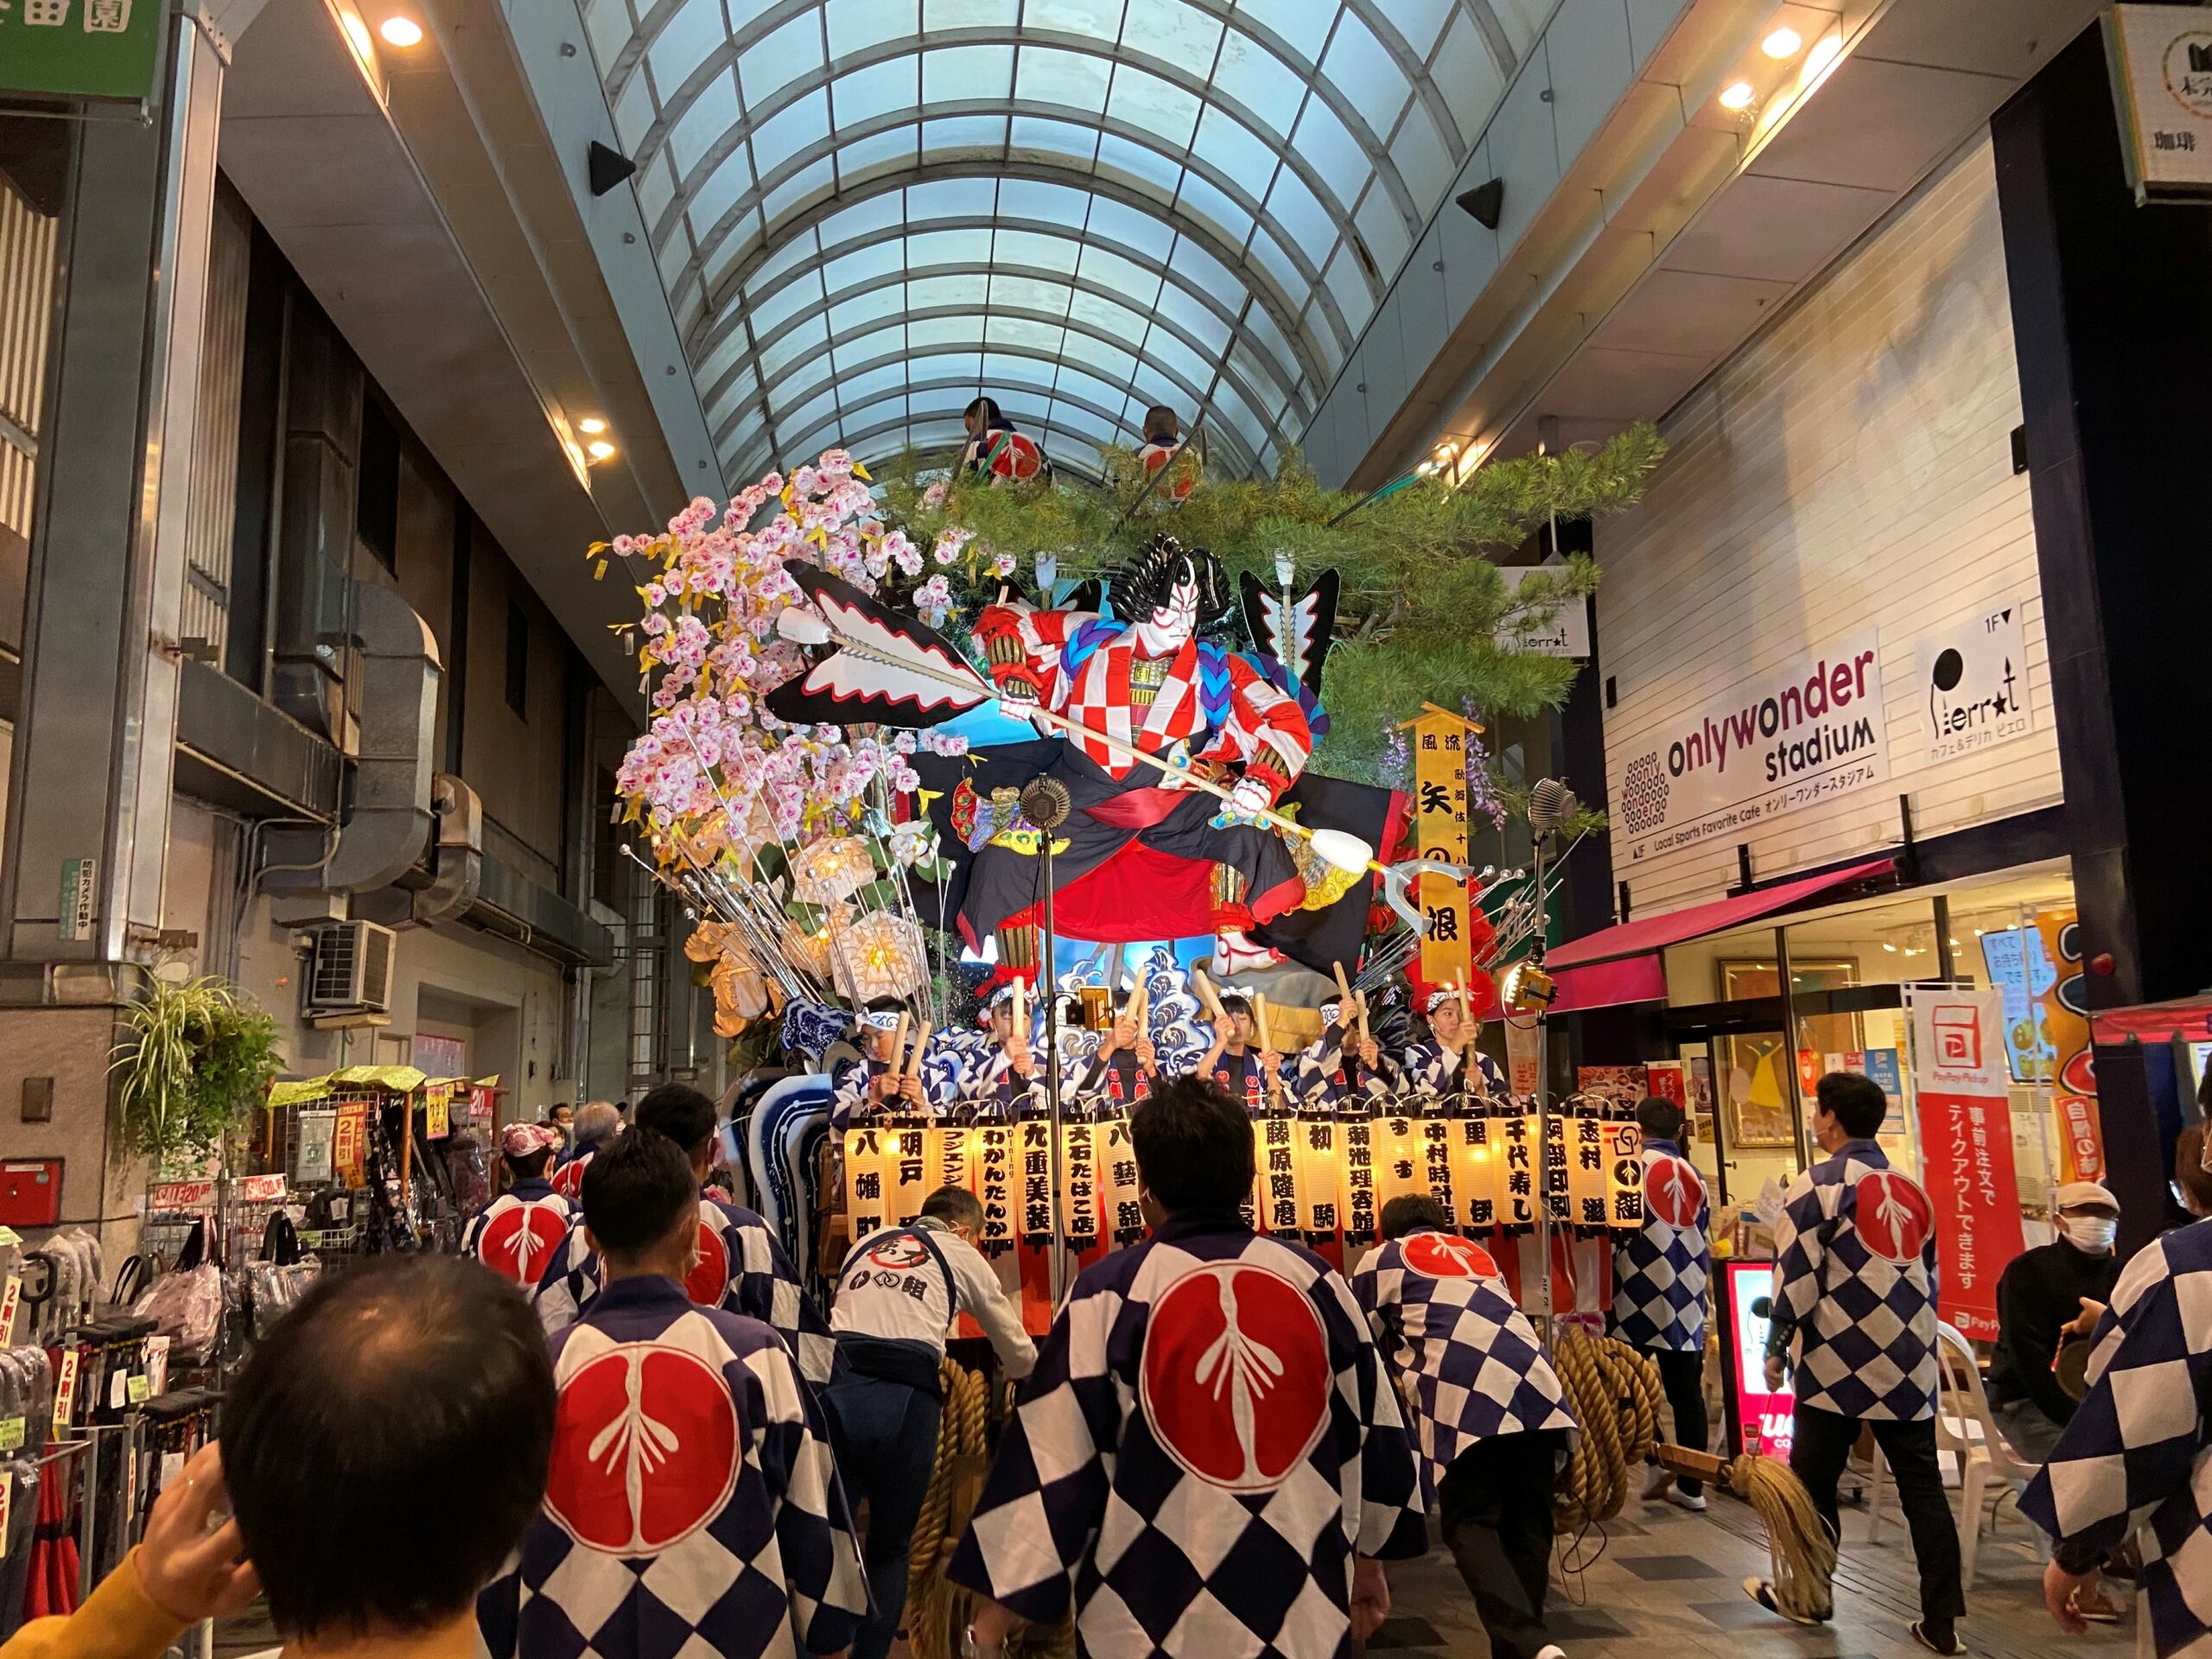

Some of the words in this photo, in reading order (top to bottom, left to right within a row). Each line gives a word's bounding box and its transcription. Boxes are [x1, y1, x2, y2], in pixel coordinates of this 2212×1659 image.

[1985, 613, 1999, 633] 1F
[1669, 651, 1874, 777] onlywonder
[1654, 834, 1674, 851] Local
[1675, 823, 1700, 845] Sports
[1702, 810, 1738, 834] Favorite
[78, 861, 92, 929] 防犯カメラ作動中
[156, 1185, 185, 1207] SALE
[983, 1130, 1007, 1237] わかんたんか
[1068, 1127, 1095, 1233] 大石たばこ店
[1505, 1119, 1532, 1221] 千代寿し
[1948, 1104, 1976, 1289] テイクアウトできます
[1968, 1107, 1995, 1206] 事前注文で
[58, 1359, 73, 1420] 2割引
